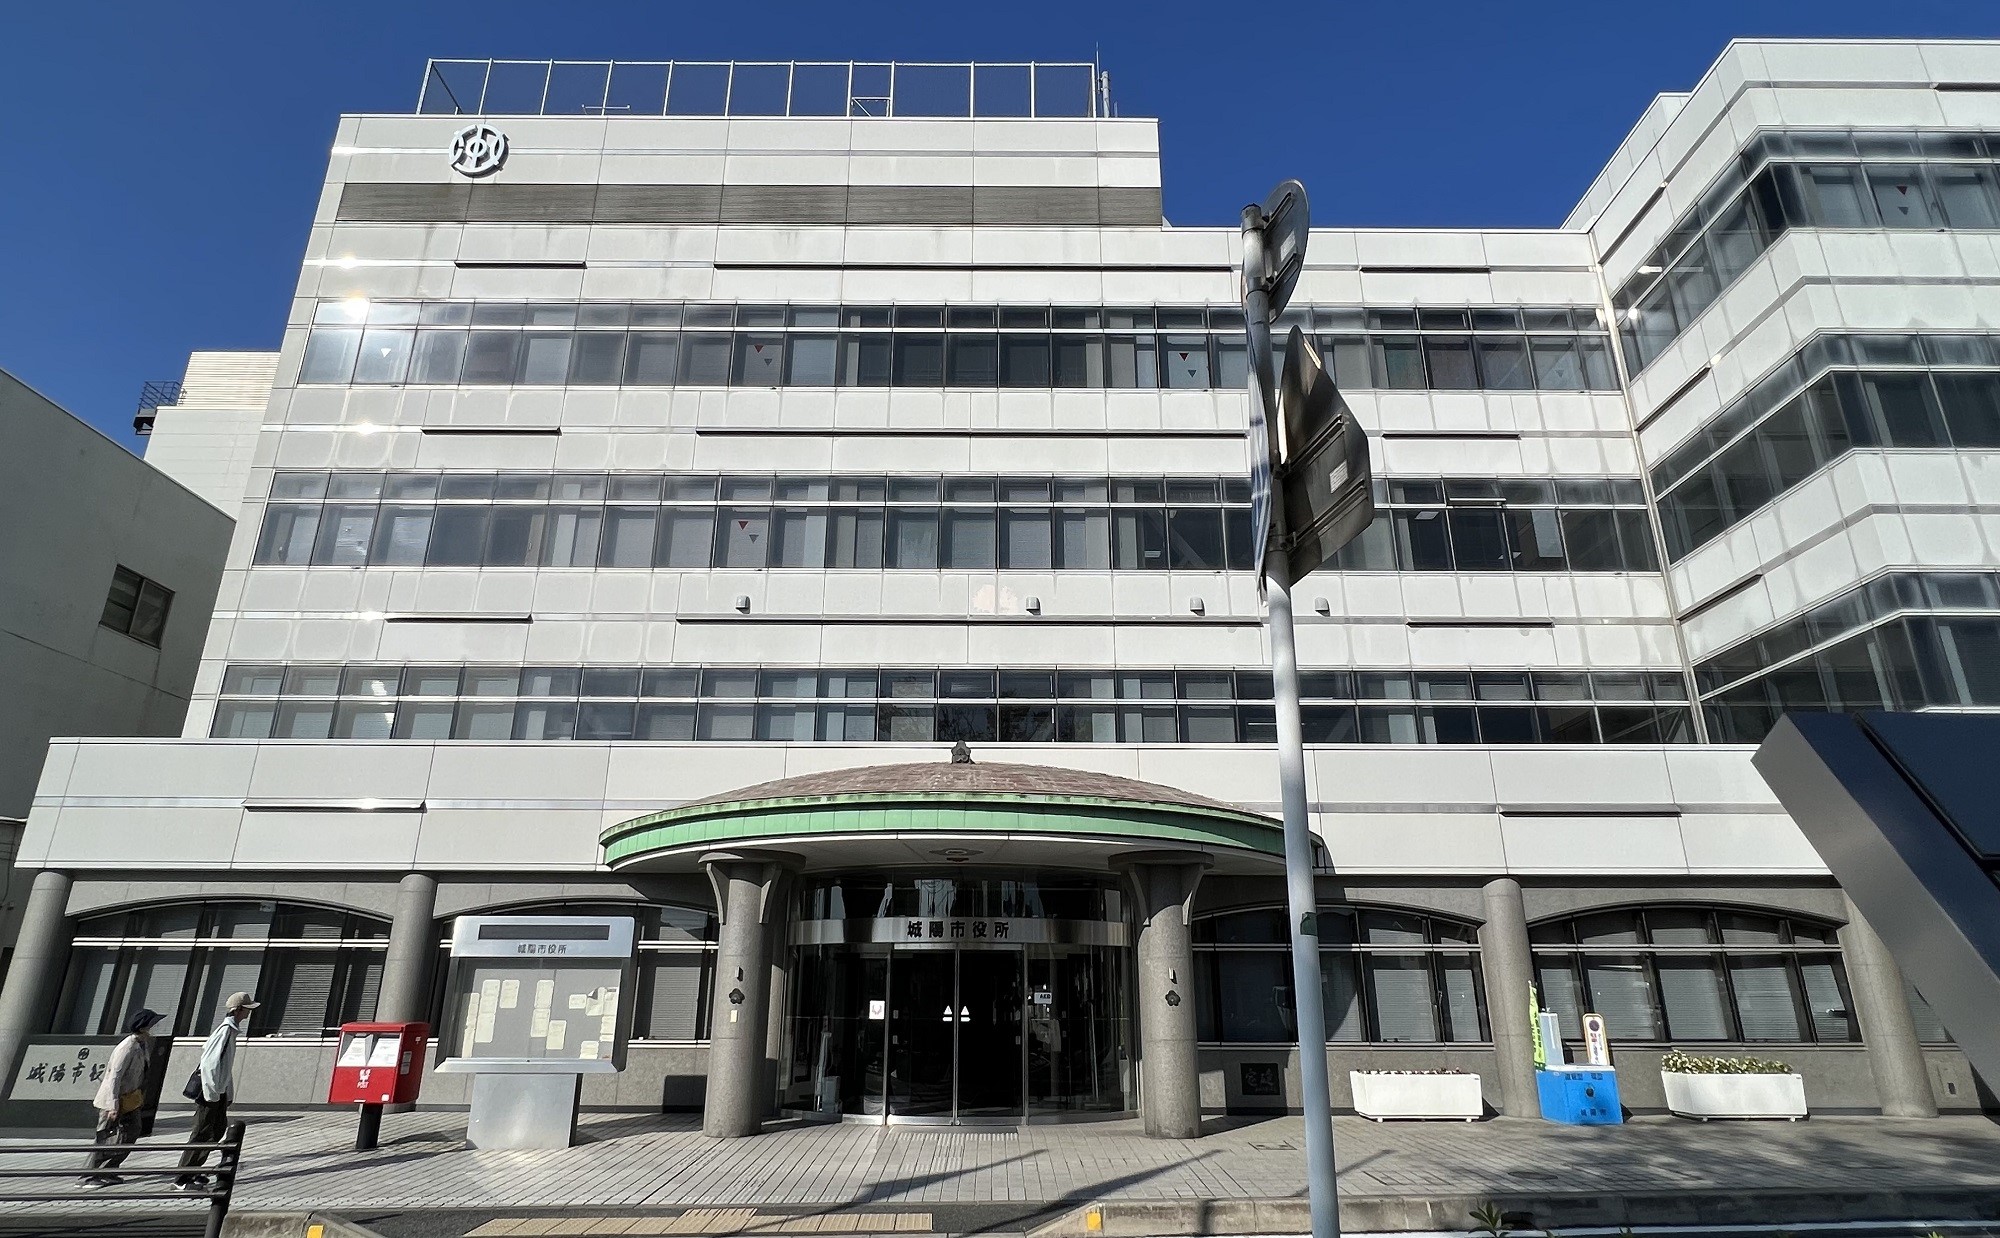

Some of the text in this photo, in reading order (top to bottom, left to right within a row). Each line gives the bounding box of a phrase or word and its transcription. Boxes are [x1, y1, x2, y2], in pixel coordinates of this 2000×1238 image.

[907, 920, 1009, 939] 城陽市役所
[517, 943, 567, 954] 城陽市役所
